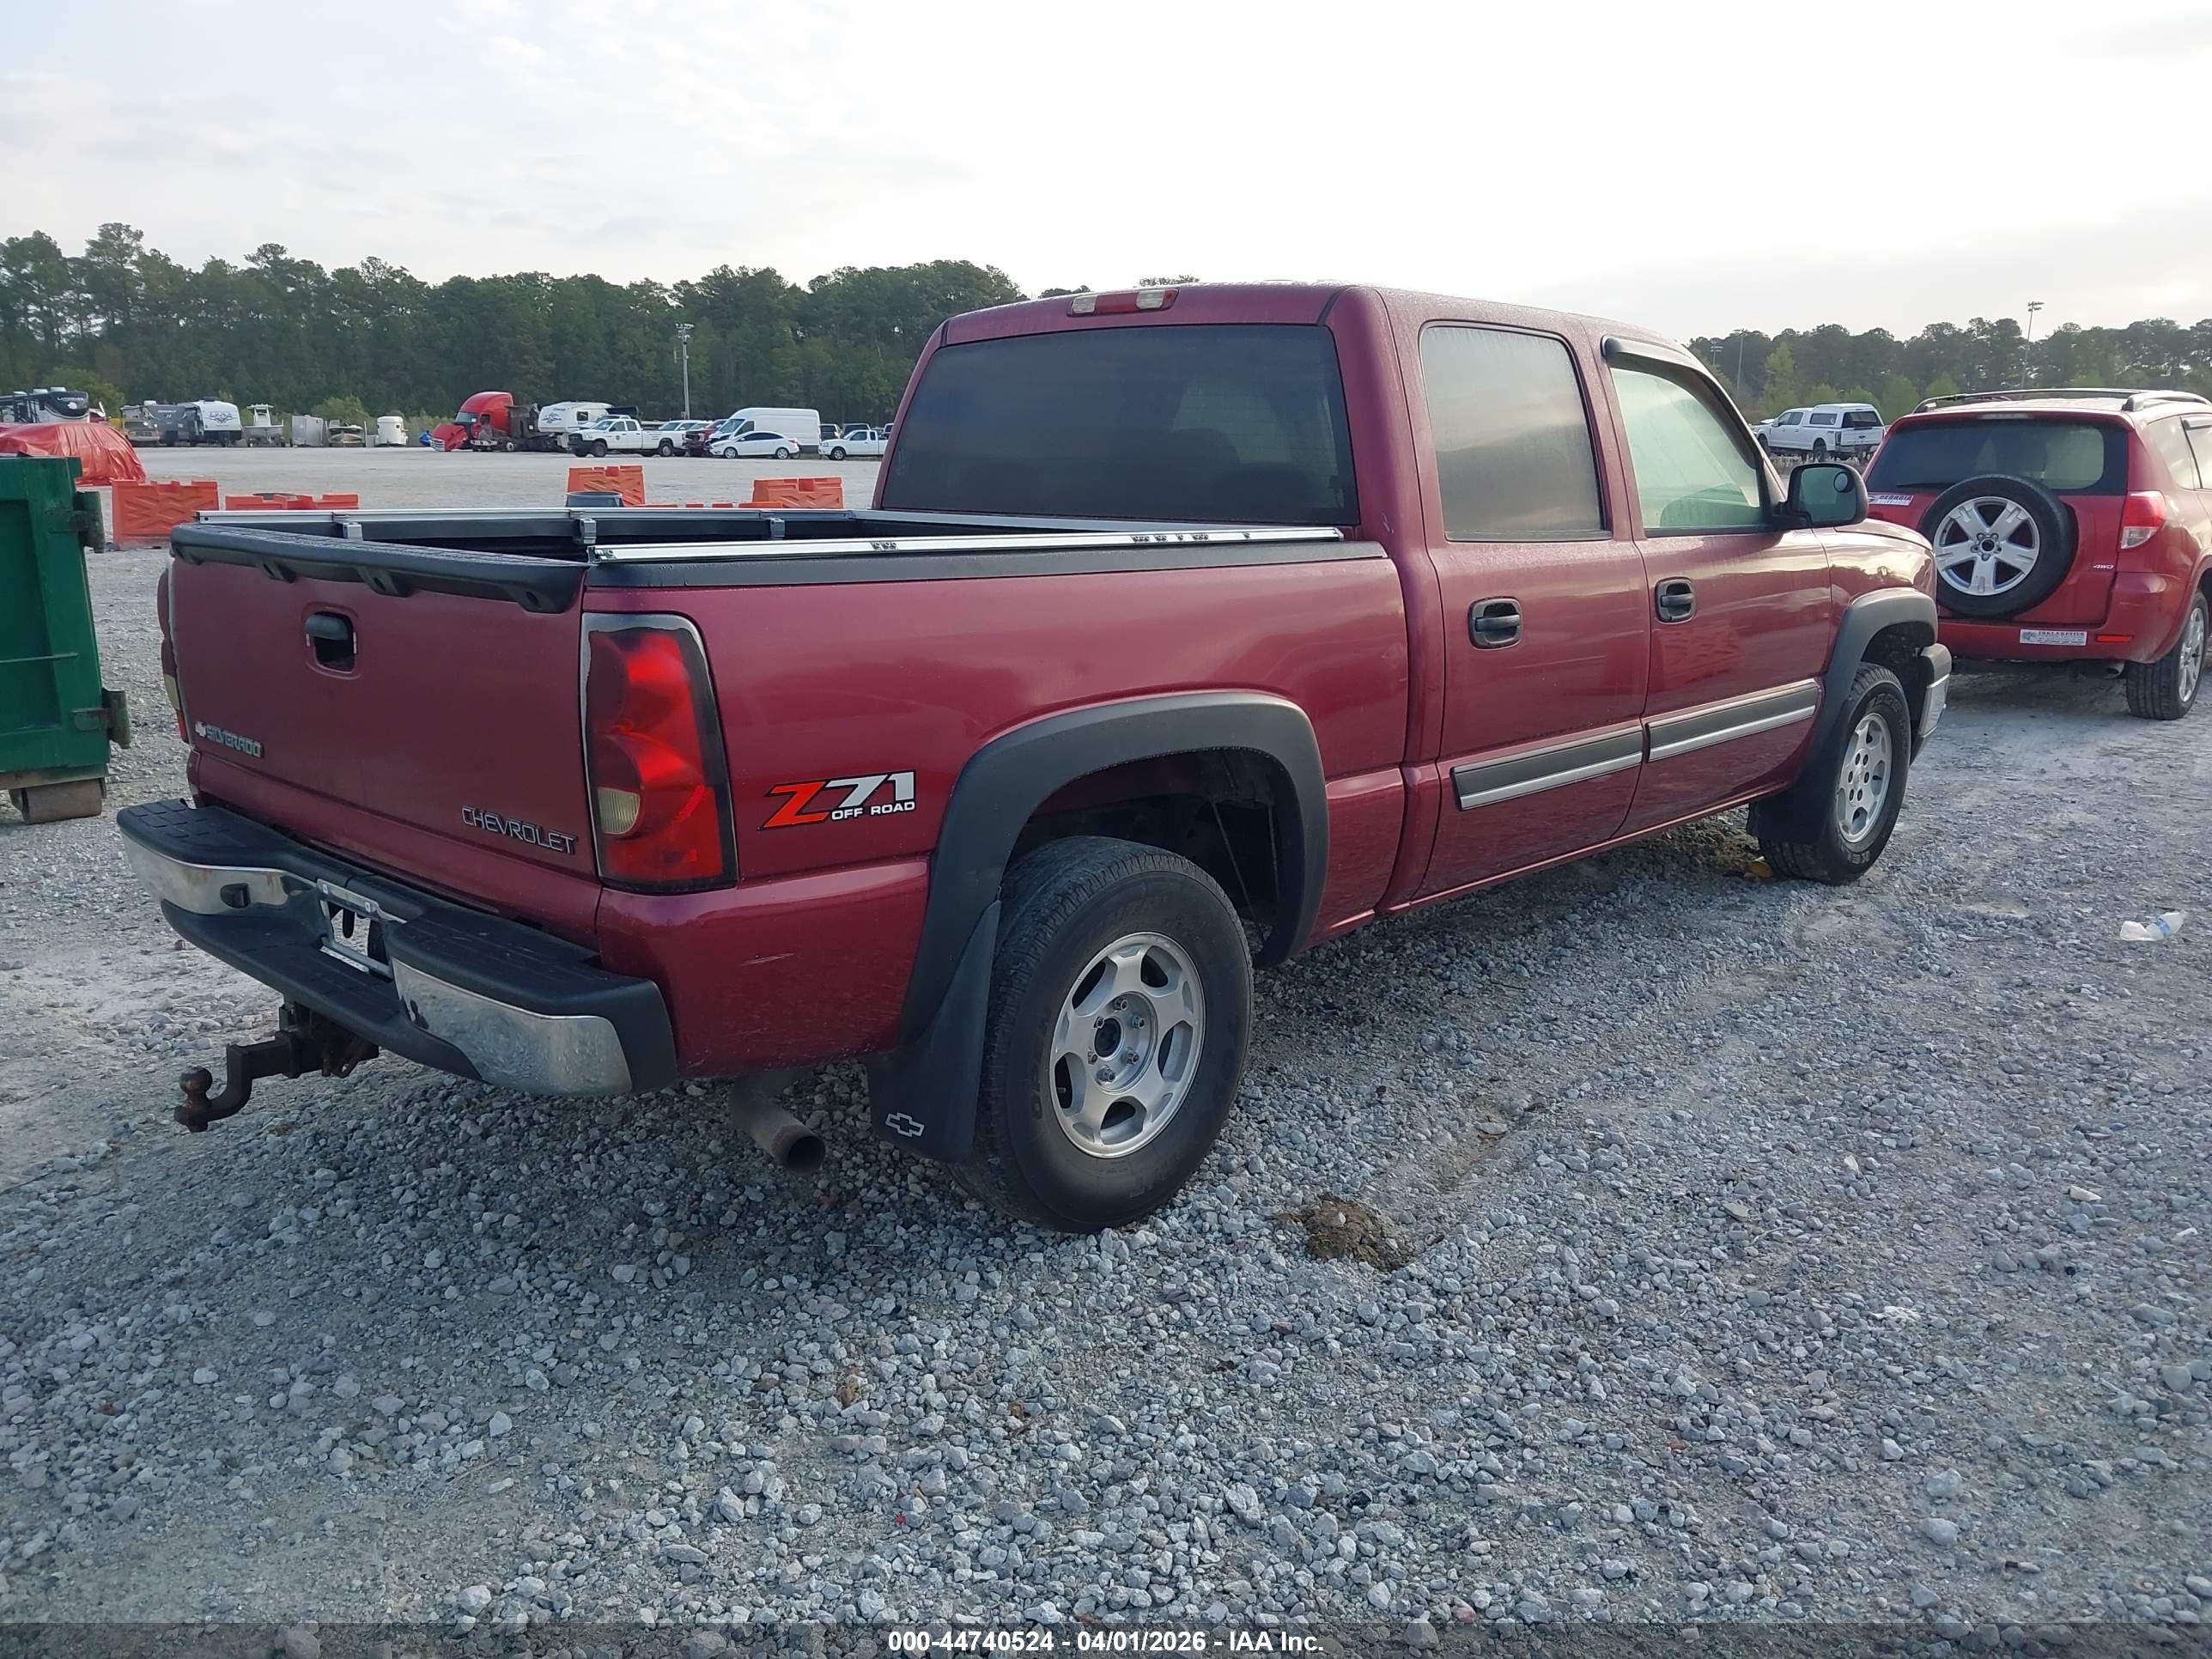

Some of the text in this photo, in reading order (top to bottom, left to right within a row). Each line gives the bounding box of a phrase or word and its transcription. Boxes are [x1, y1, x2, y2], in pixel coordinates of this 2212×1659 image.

[205, 725, 262, 758] SILVERADO
[763, 770, 915, 829] Z71
[830, 801, 915, 820] OFF ROAD
[461, 806, 575, 854] CHEVROLET
